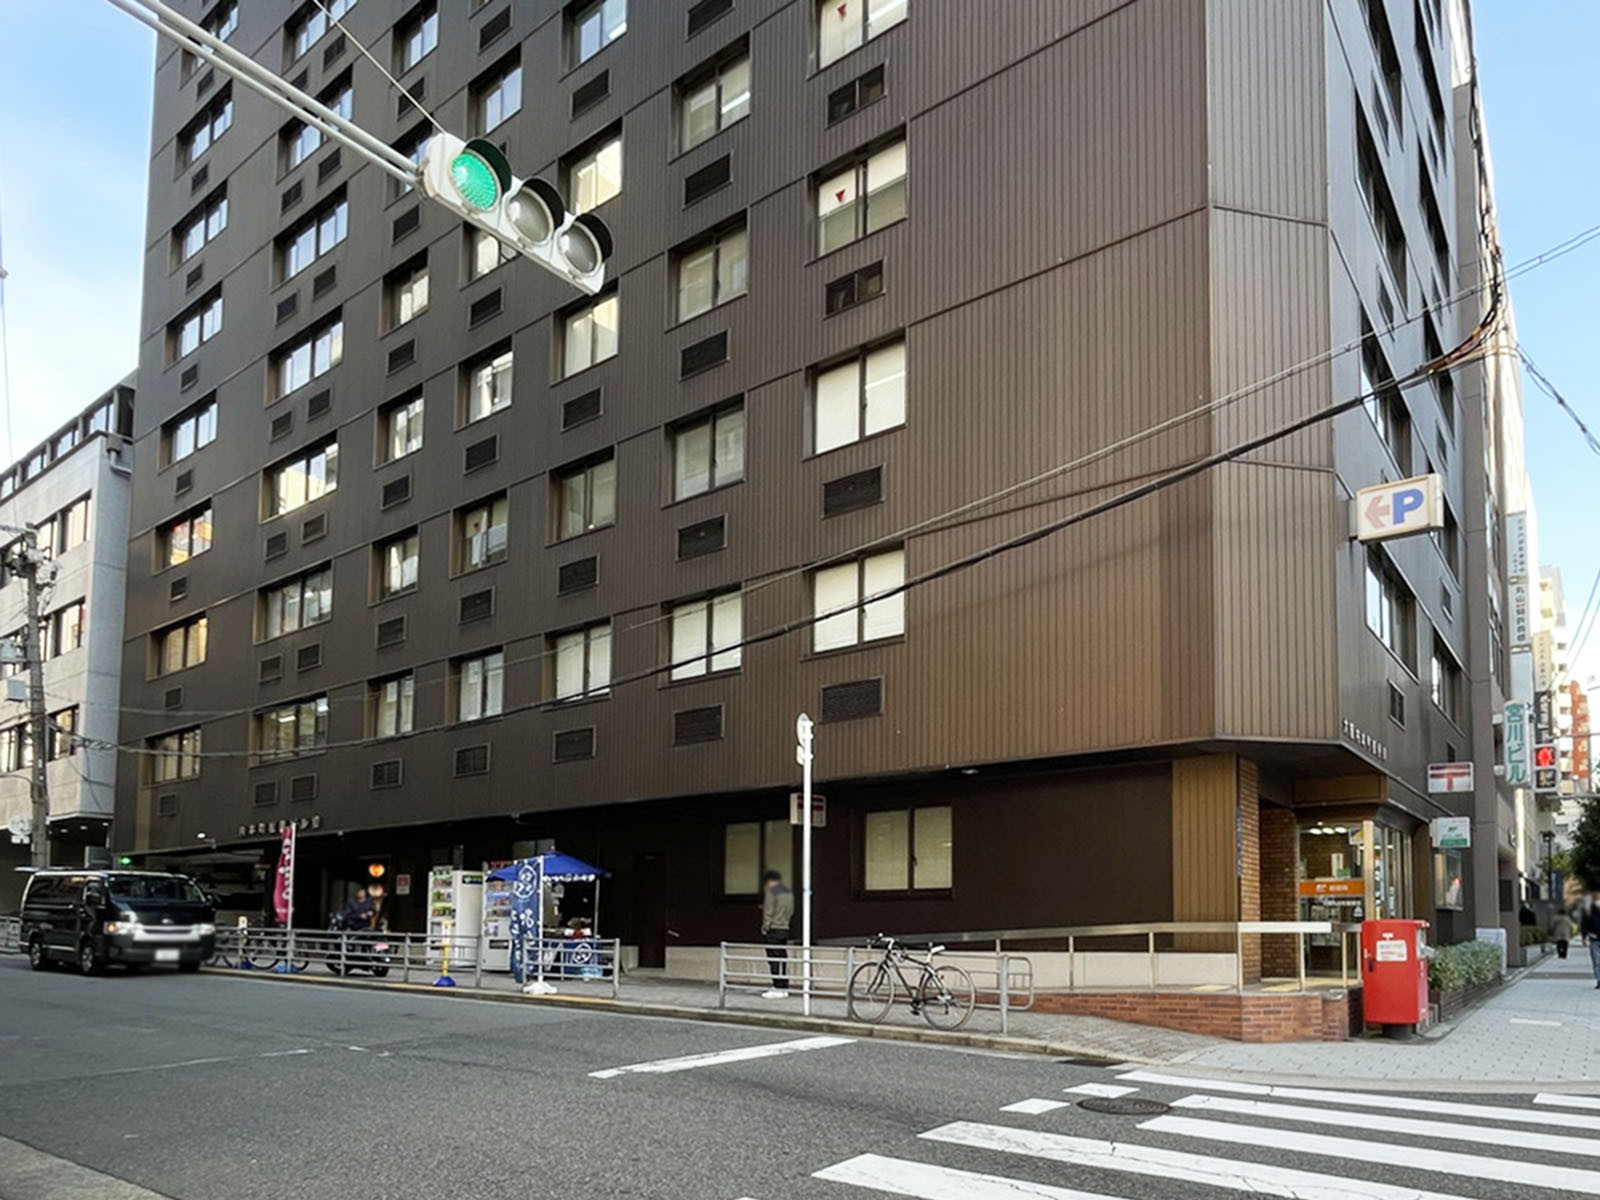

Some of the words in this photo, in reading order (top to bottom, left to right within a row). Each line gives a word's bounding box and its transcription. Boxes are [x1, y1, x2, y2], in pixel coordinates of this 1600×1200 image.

[1393, 488, 1424, 525] P
[1504, 704, 1526, 783] 宮川ビル
